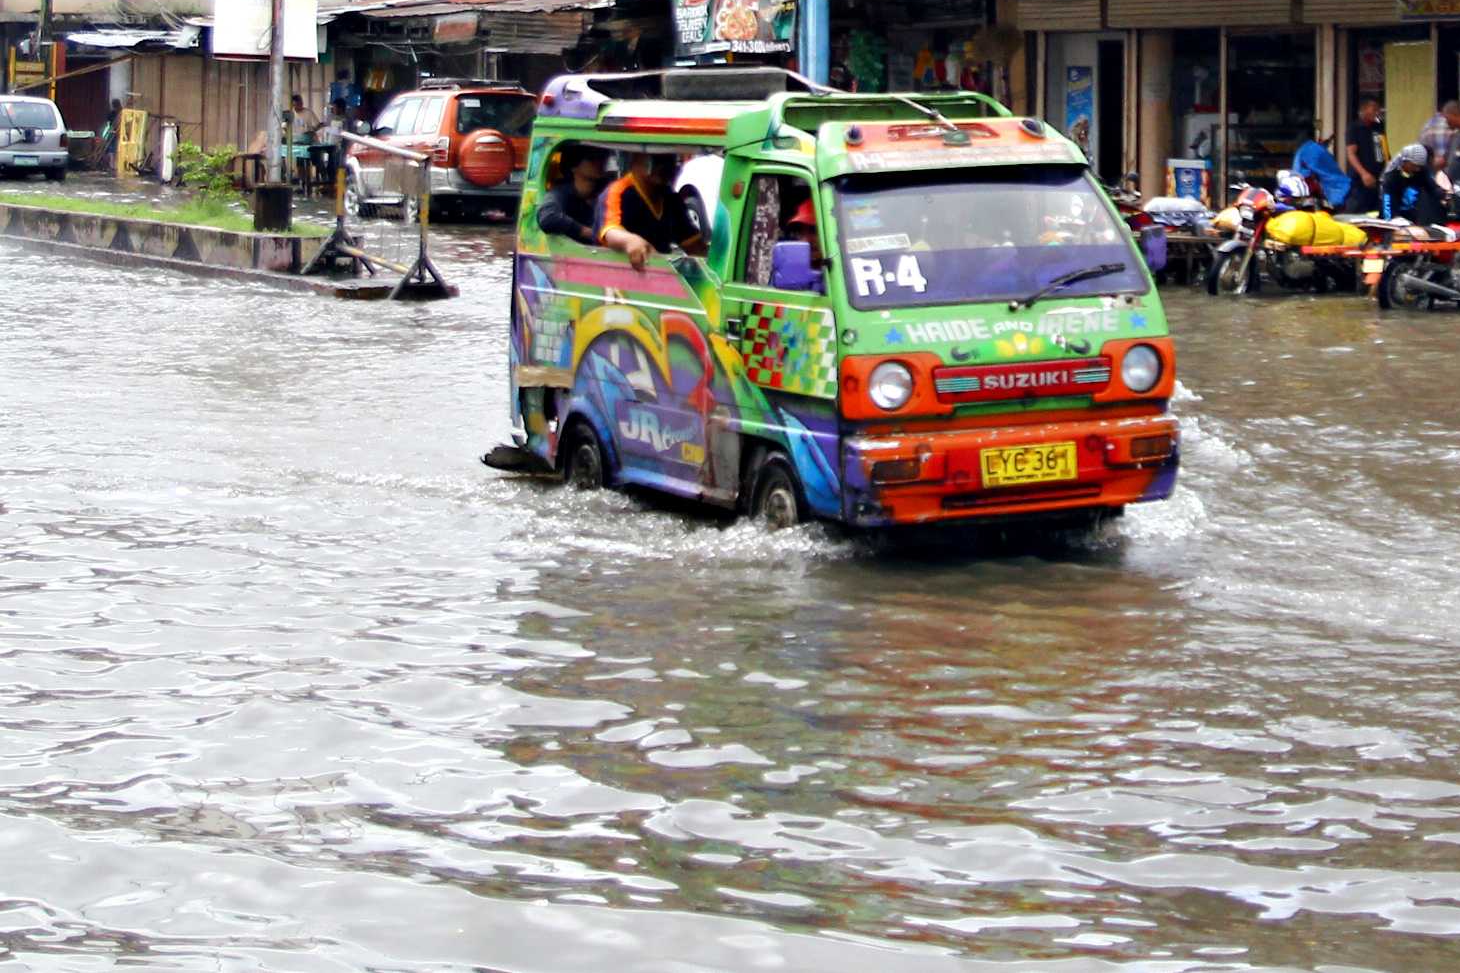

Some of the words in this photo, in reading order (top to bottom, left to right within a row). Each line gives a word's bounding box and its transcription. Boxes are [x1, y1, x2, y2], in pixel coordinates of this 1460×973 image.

[850, 254, 928, 297] R-4
[906, 318, 993, 344] HAIDE
[992, 320, 1034, 333] AND
[982, 370, 1069, 389] SUZUKI
[985, 448, 1025, 475] LYC
